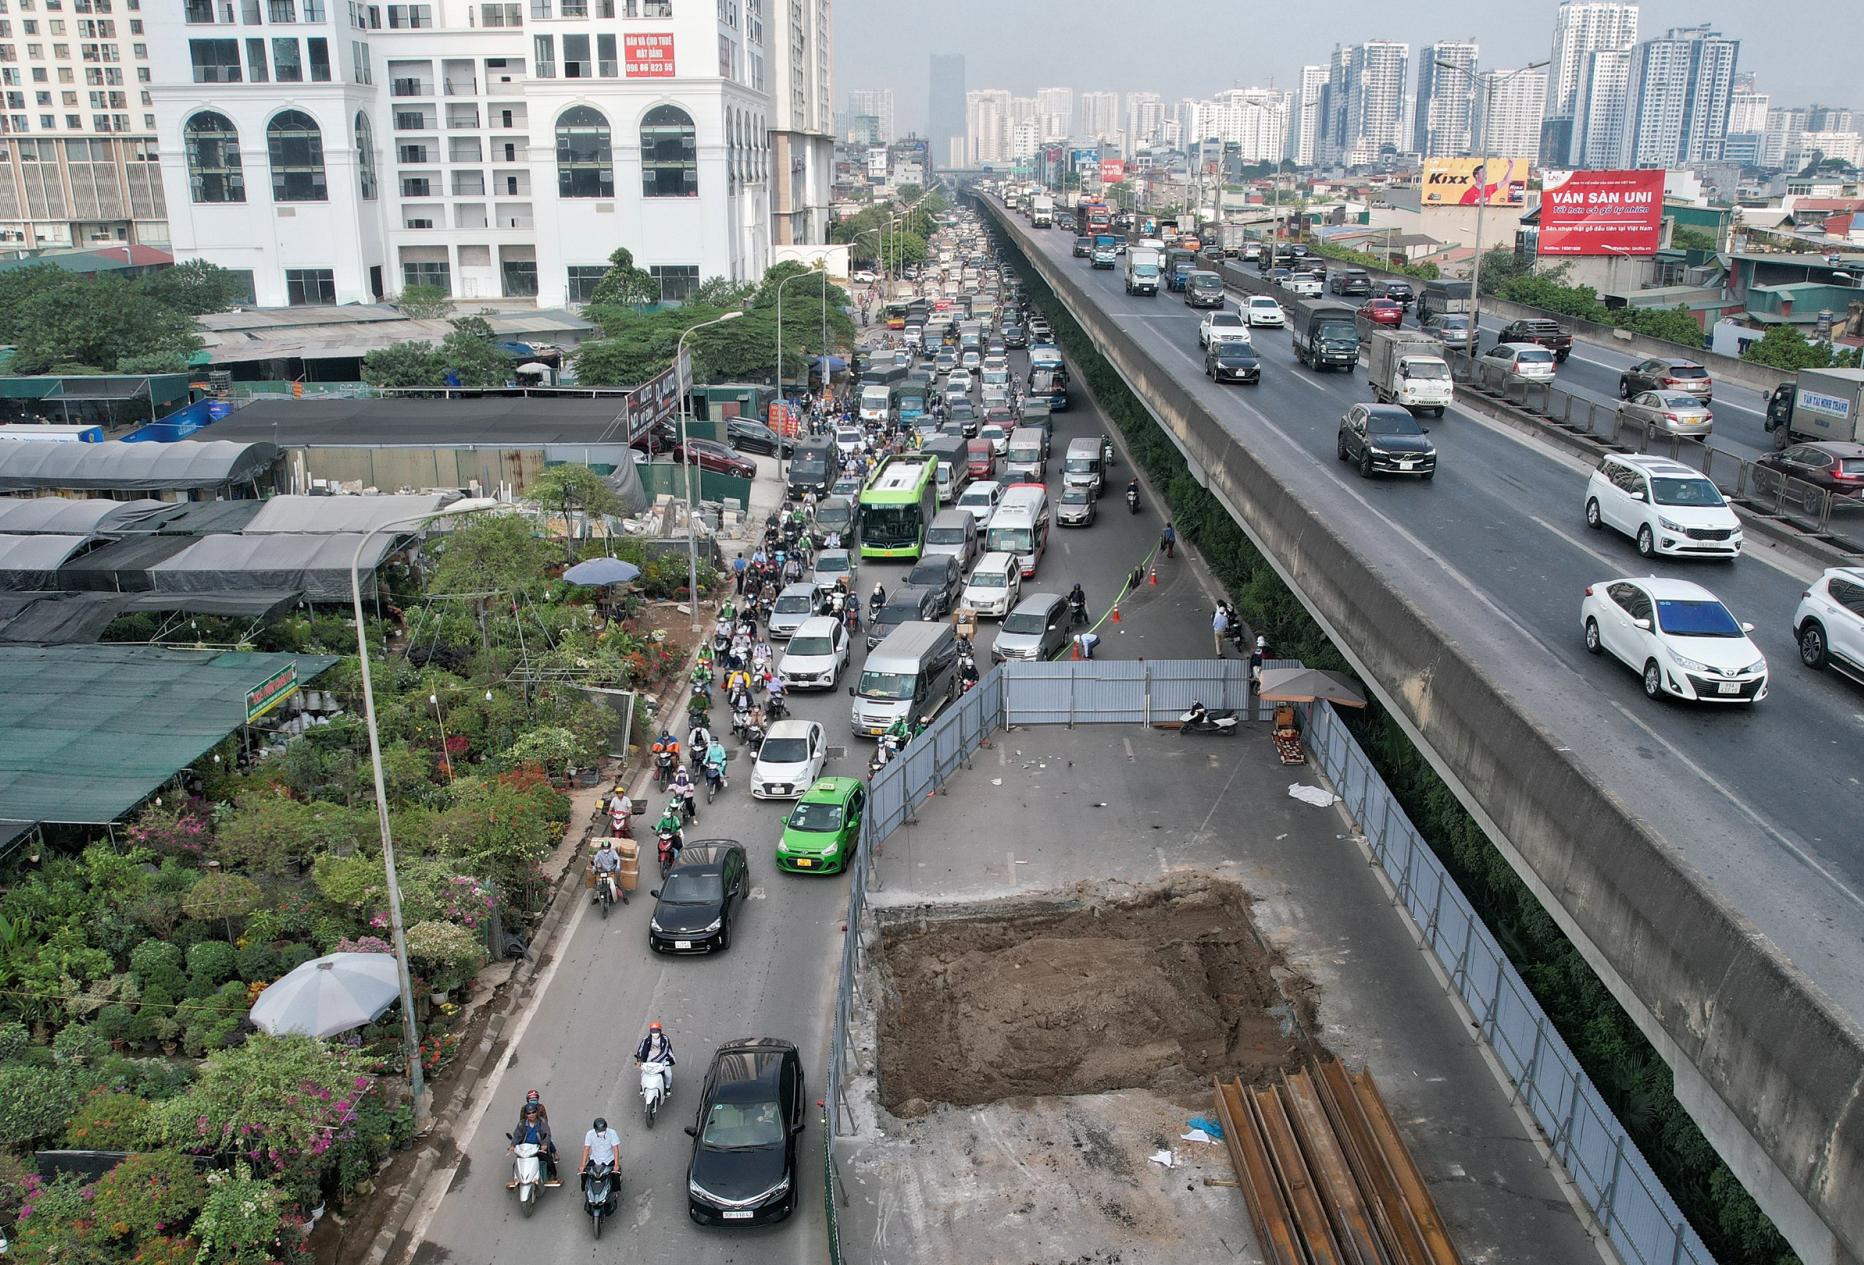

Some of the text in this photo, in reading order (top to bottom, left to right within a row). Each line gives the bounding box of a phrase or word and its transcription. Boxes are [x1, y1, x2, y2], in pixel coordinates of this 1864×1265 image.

[1428, 173, 1469, 184] Kixx
[1552, 190, 1652, 203] VÁN SÀN UNI
